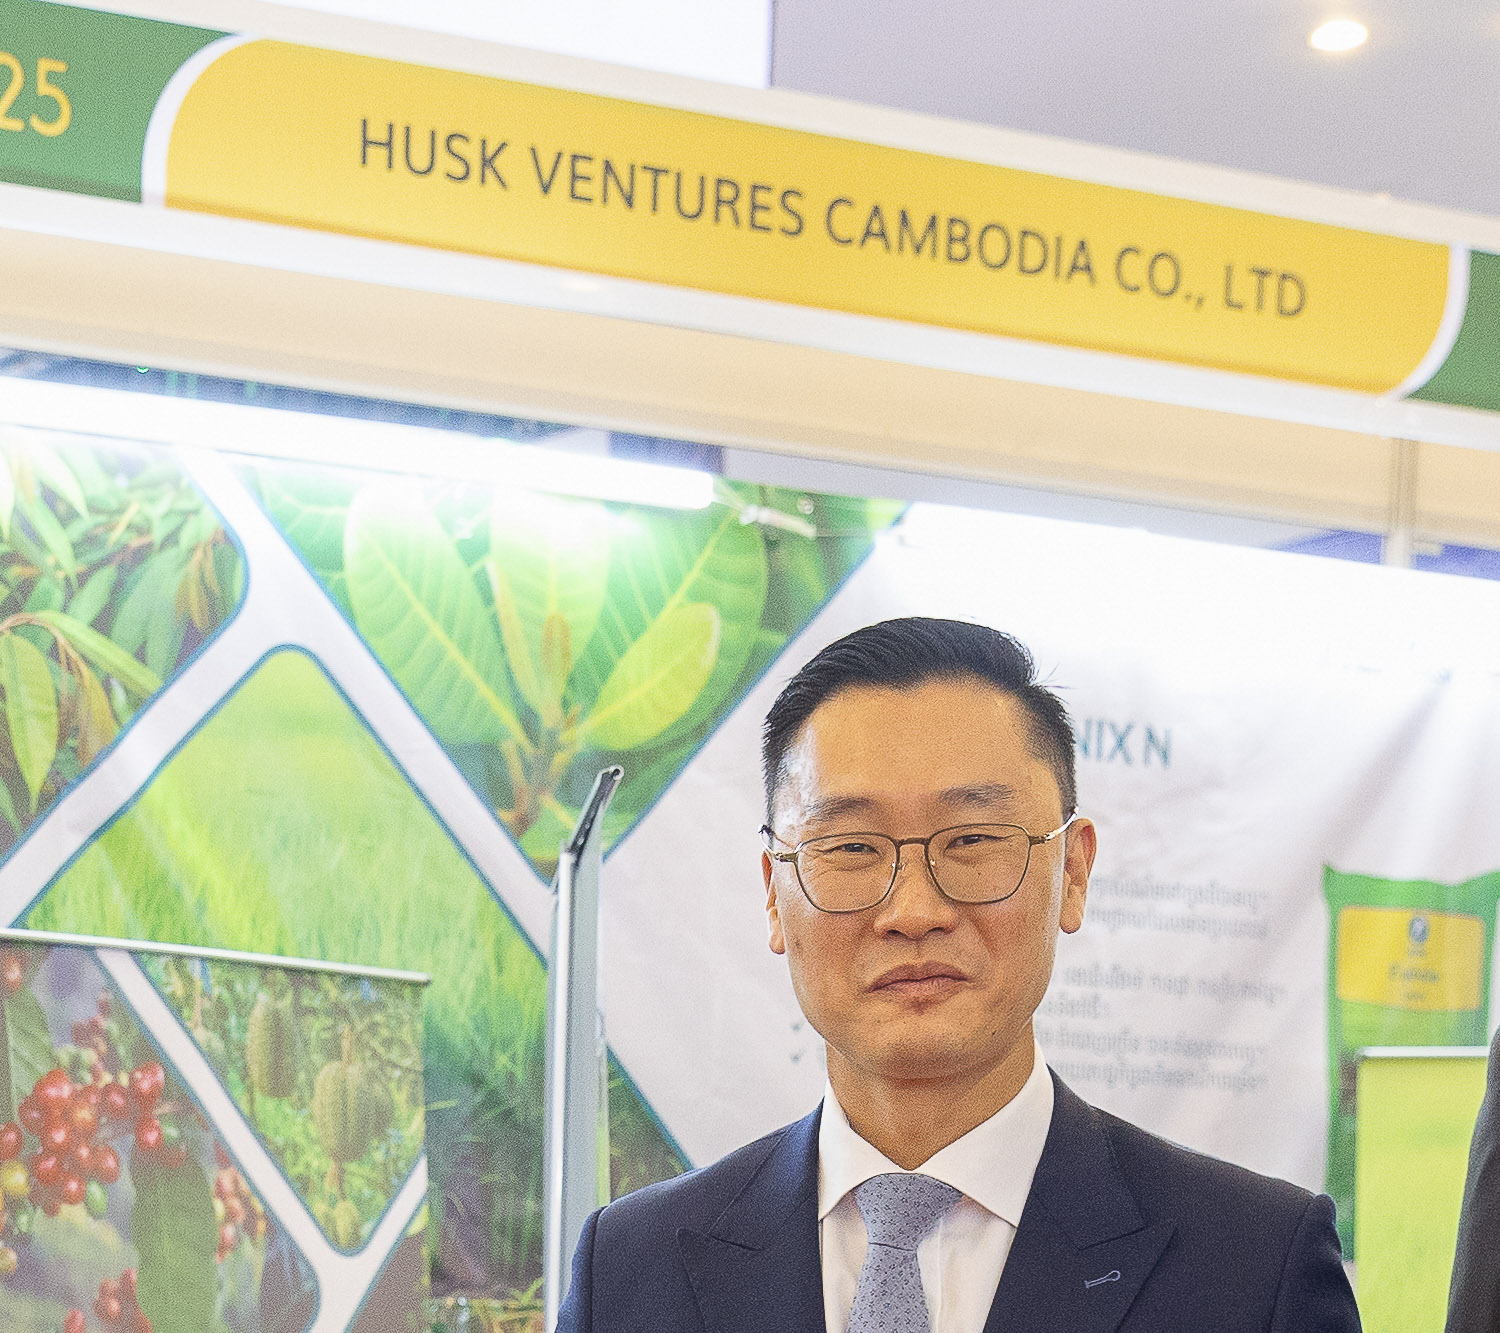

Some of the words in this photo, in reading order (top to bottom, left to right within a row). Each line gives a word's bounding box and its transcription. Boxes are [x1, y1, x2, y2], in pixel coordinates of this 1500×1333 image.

[360, 117, 508, 189] HUSK
[530, 146, 805, 239] VENTURES
[826, 196, 1096, 285] CAMBODIA
[1115, 245, 1204, 308] CO.,
[1225, 266, 1307, 320] LTD
